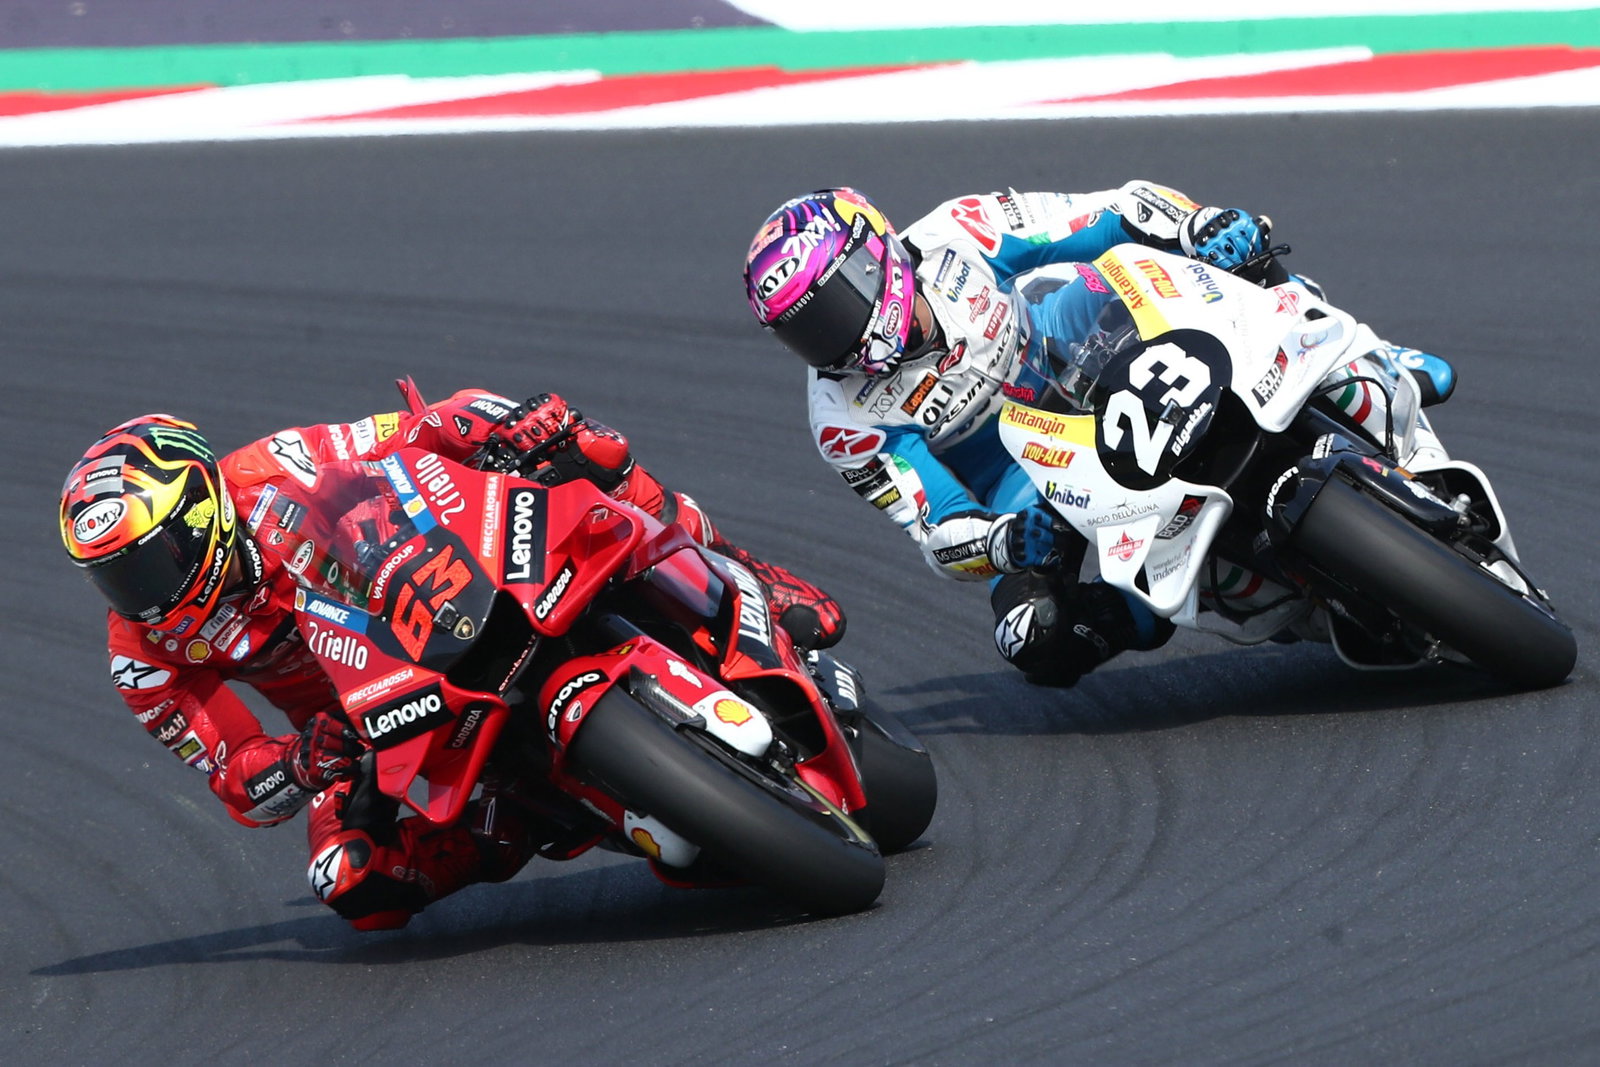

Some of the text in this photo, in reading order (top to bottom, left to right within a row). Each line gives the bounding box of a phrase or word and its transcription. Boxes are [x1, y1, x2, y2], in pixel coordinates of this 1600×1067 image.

[762, 262, 792, 293] KYT
[947, 261, 972, 303] Unibat
[1102, 258, 1147, 309] Antangin
[1186, 263, 1224, 304] Unibat
[780, 290, 815, 321] TERRANOVA
[888, 308, 899, 333] PATA
[987, 303, 1005, 334] ASPIRA
[869, 371, 905, 419] KYT
[1254, 363, 1281, 397] BOLD
[929, 376, 986, 439] GRESINI
[1006, 405, 1066, 435] Antangin
[1102, 342, 1211, 476] 23
[86, 467, 119, 482] Lenovo
[1023, 442, 1075, 469] YOU-ALL
[1045, 480, 1091, 509] Unibat
[1266, 466, 1299, 519] DUCATI
[75, 508, 119, 535] SUOMY
[278, 503, 296, 528] Lenovo
[482, 475, 499, 558] FRECCIAROSSA
[1111, 507, 1138, 521] DELLA
[1137, 503, 1160, 515] LUNA
[1159, 514, 1188, 539] BOLD
[506, 491, 535, 580] Lenovo
[948, 545, 968, 560] GLOW
[197, 547, 223, 603] Lenovo
[245, 539, 263, 585] Lenovo
[293, 542, 314, 570] UOMY
[373, 544, 414, 600] VARGROUP
[307, 599, 350, 625] ADVANCE
[391, 544, 473, 663] 63
[535, 568, 572, 619] CARRERA
[726, 562, 769, 647] Lenovo
[232, 639, 249, 660] SAP
[346, 668, 414, 706] FRECCIAROSSA
[364, 693, 442, 740] Lenovo
[547, 672, 600, 746] Lenovo
[451, 708, 483, 749] CARRERA
[248, 770, 285, 800] Lenovo
